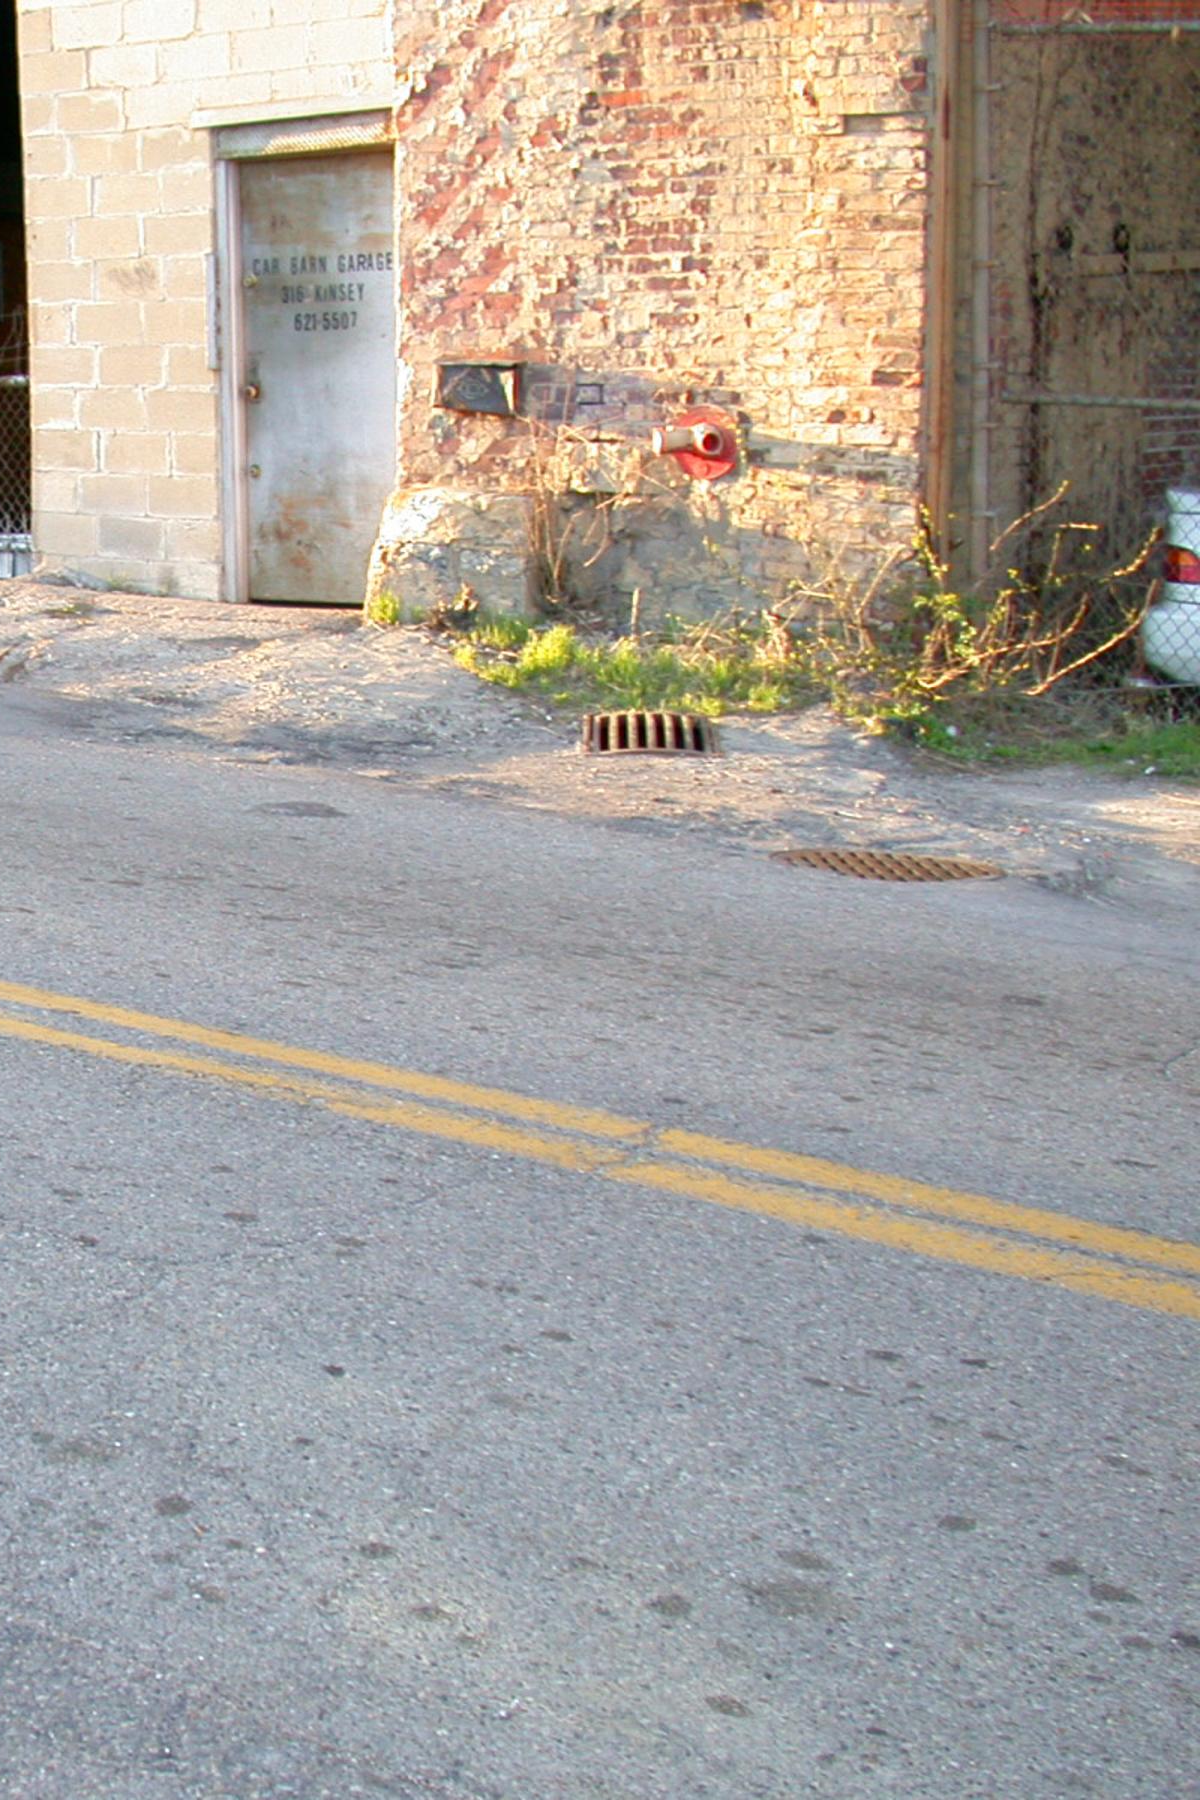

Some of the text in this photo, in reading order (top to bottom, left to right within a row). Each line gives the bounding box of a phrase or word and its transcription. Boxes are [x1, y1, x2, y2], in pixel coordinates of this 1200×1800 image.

[252, 252, 393, 276] CAR BARN GARAGE
[314, 283, 365, 302] KINSEY
[294, 311, 358, 331] 621-5507
